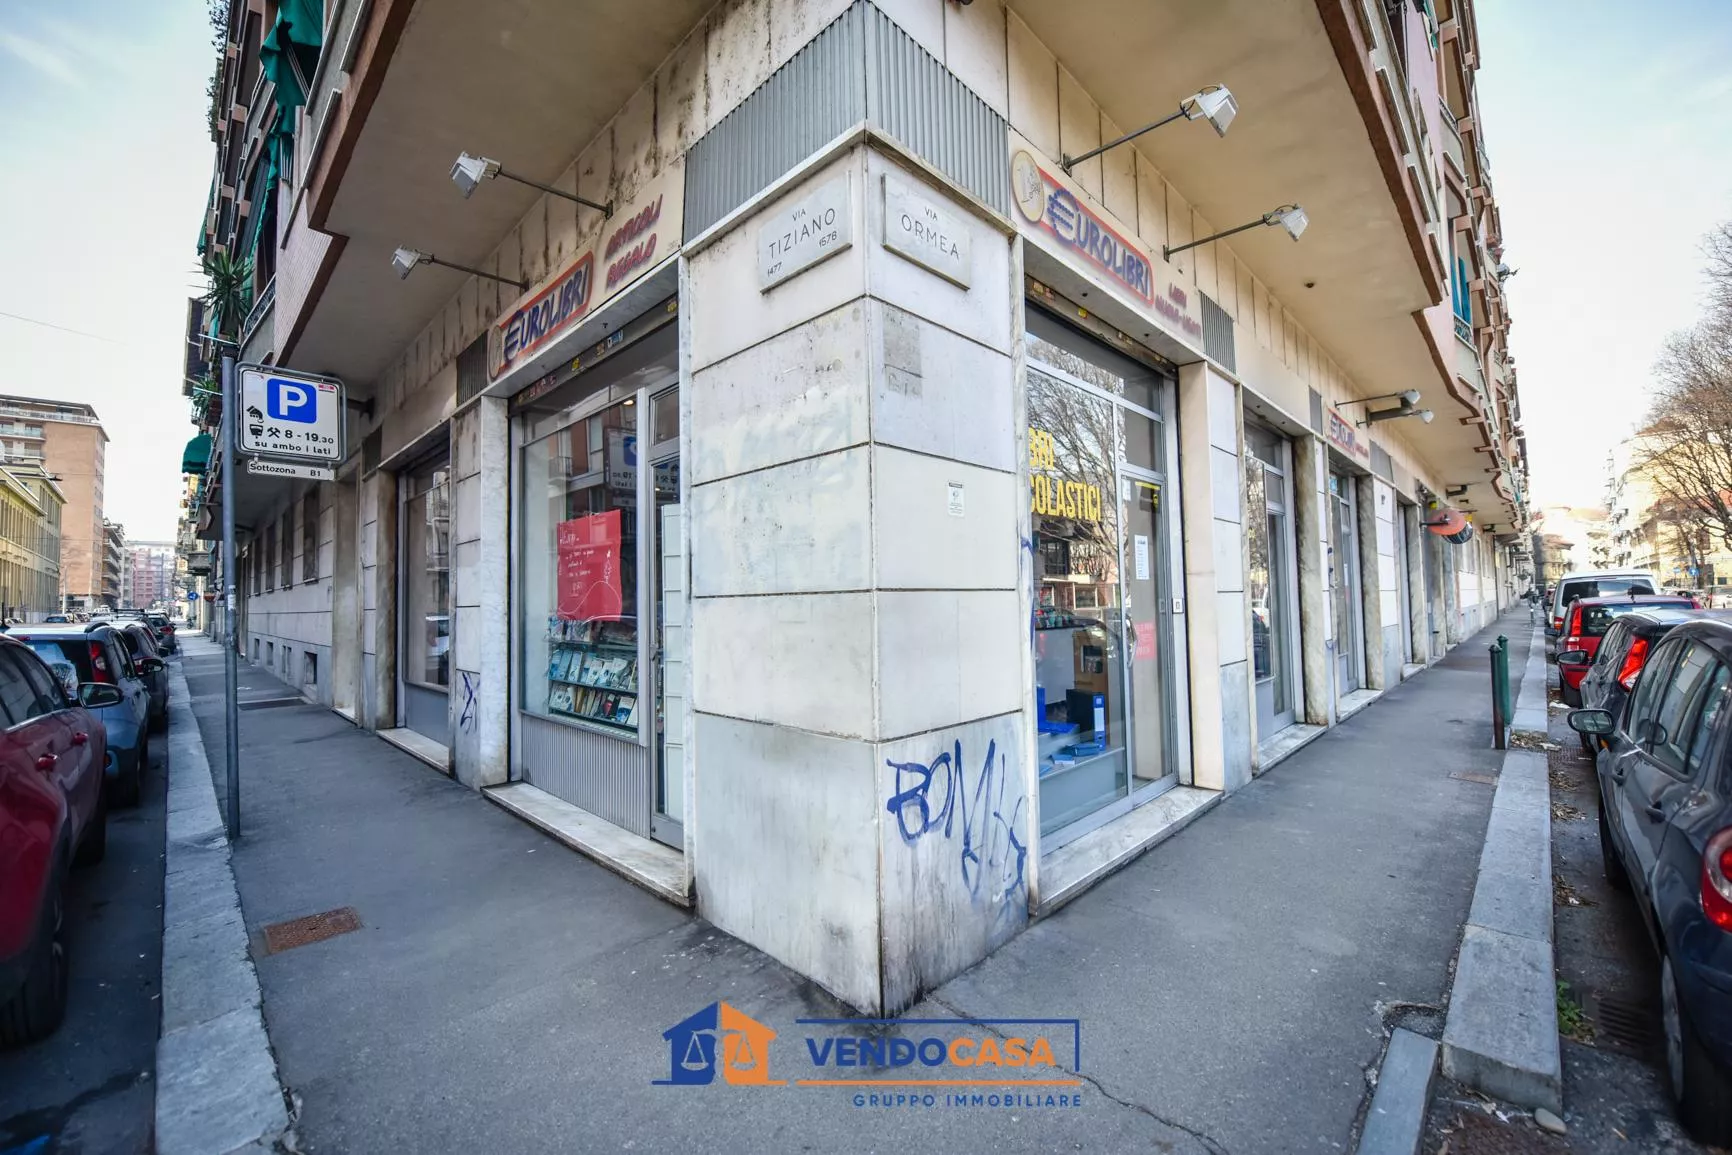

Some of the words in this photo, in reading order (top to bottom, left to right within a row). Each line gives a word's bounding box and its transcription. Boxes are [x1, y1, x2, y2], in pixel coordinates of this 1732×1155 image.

[792, 208, 806, 221] VIA
[924, 206, 938, 221] VIA
[769, 208, 836, 259] TIZIANO
[901, 214, 960, 261] ORMEA
[767, 262, 782, 277] 1477
[279, 384, 308, 417] P
[284, 429, 293, 439] 8
[304, 432, 334, 445] 19.30
[272, 442, 302, 452] ambo
[313, 446, 331, 455] lati
[249, 462, 296, 475] Sottozona
